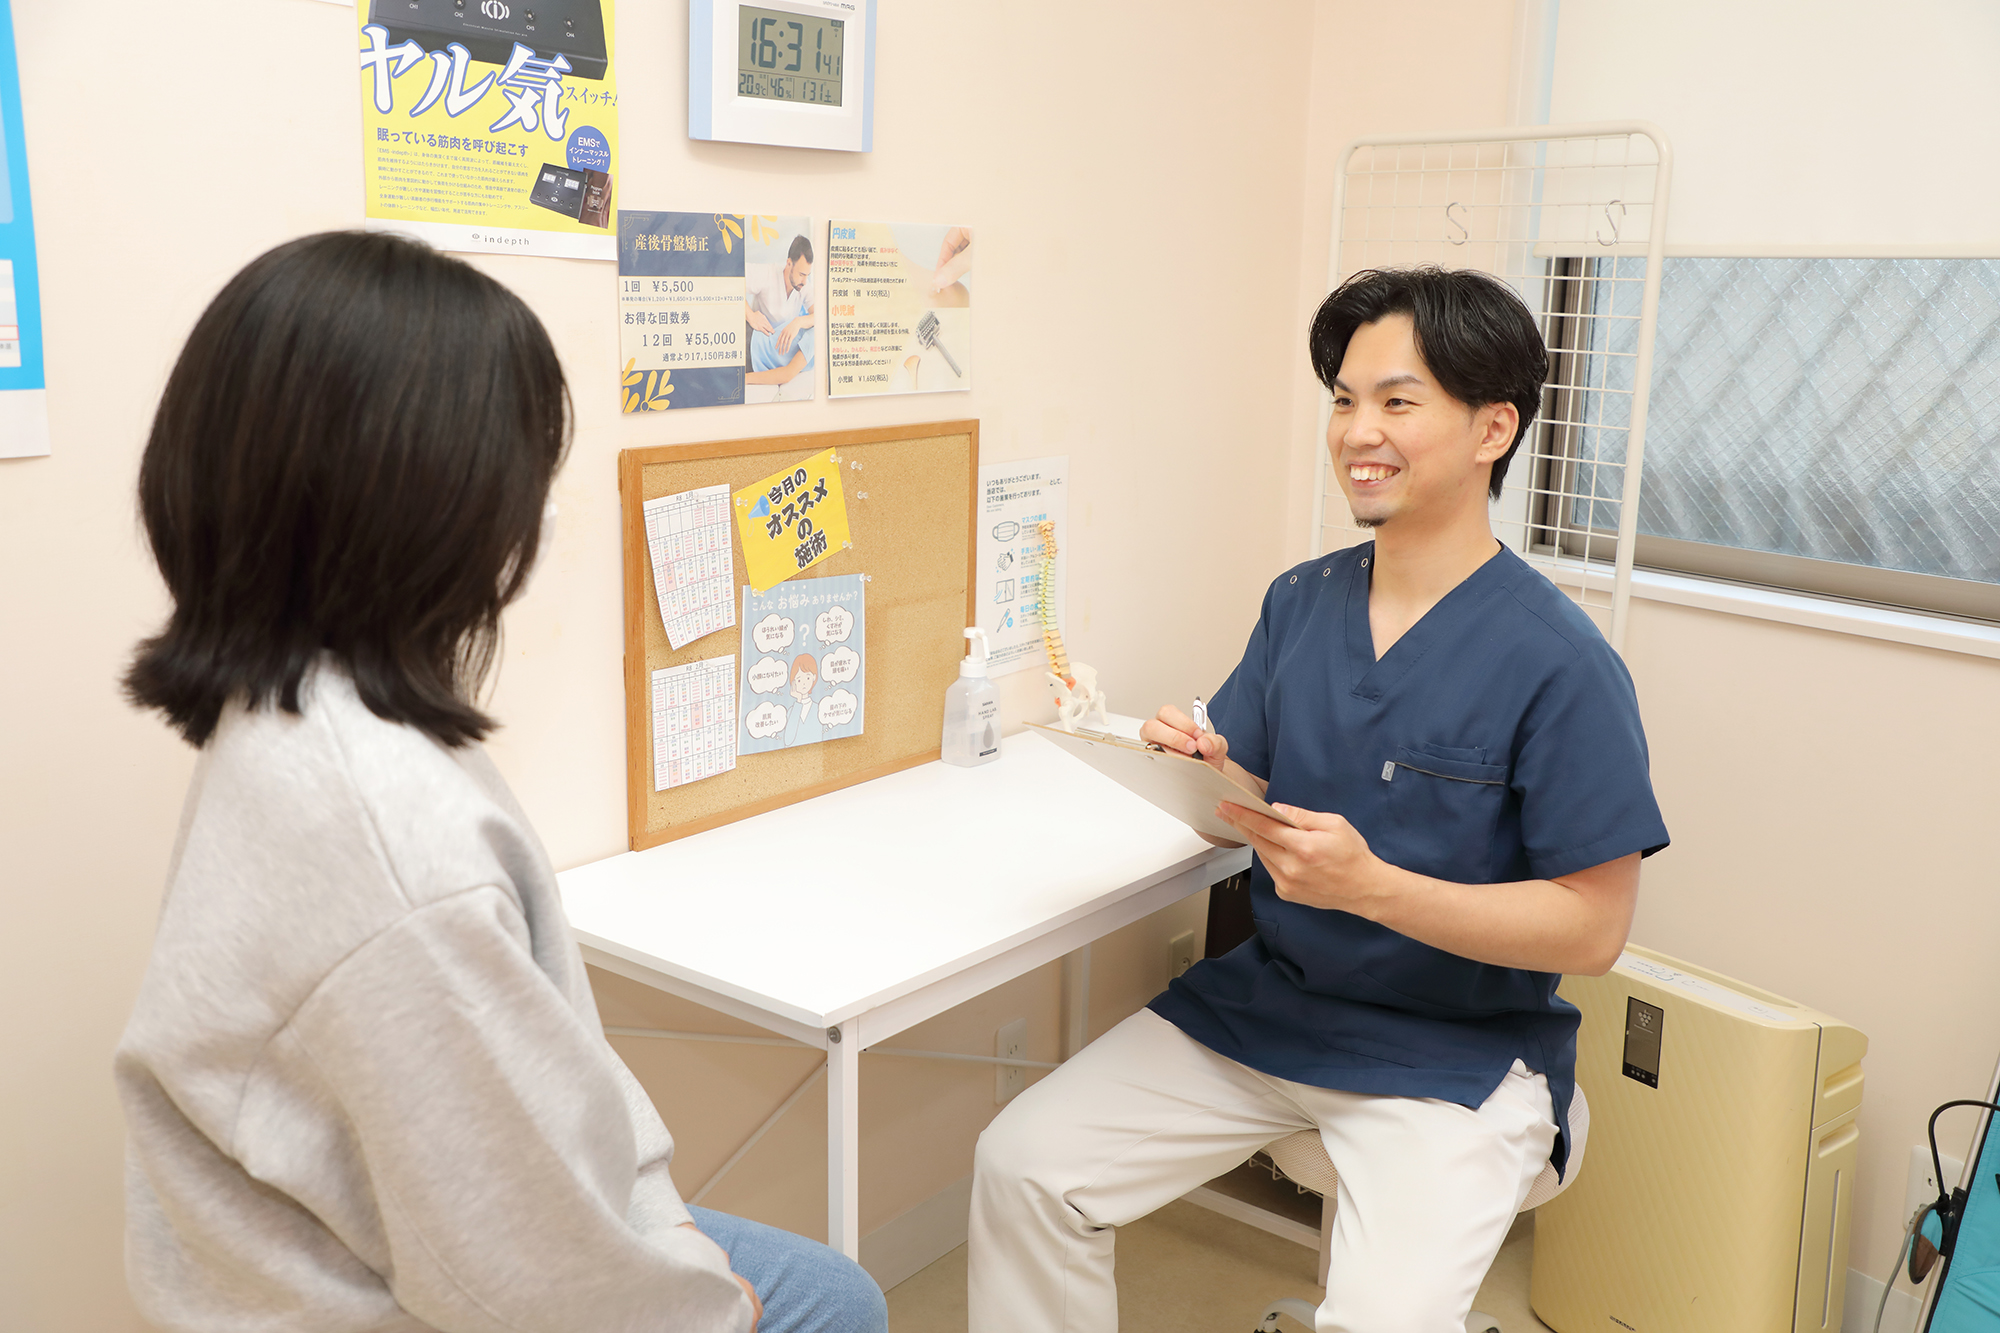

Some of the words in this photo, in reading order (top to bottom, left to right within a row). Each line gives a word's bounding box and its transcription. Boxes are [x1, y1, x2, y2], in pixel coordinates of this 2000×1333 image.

[751, 17, 822, 73] 16:31
[823, 54, 840, 76] 41
[360, 23, 572, 140] ヤル気
[824, 89, 833, 103] 土
[377, 127, 528, 157] 眠っている筋肉を呼び起こす
[578, 137, 601, 148] EMSで
[569, 147, 609, 158] インナーマッスル
[572, 156, 605, 167] トレーニング!
[484, 235, 530, 246] indepth
[635, 233, 709, 252] 産後骨盤矯正
[624, 280, 640, 292] 1回
[652, 280, 694, 293] ¥5,500
[624, 311, 690, 325] お得な回数券
[685, 331, 736, 347] ¥55,000
[662, 350, 743, 362] 通常より17,150円お得!
[766, 467, 807, 505] 今月の
[765, 477, 829, 540] オススメ
[797, 517, 813, 540] の
[794, 529, 828, 569] 施術
[778, 594, 810, 610] お悩み
